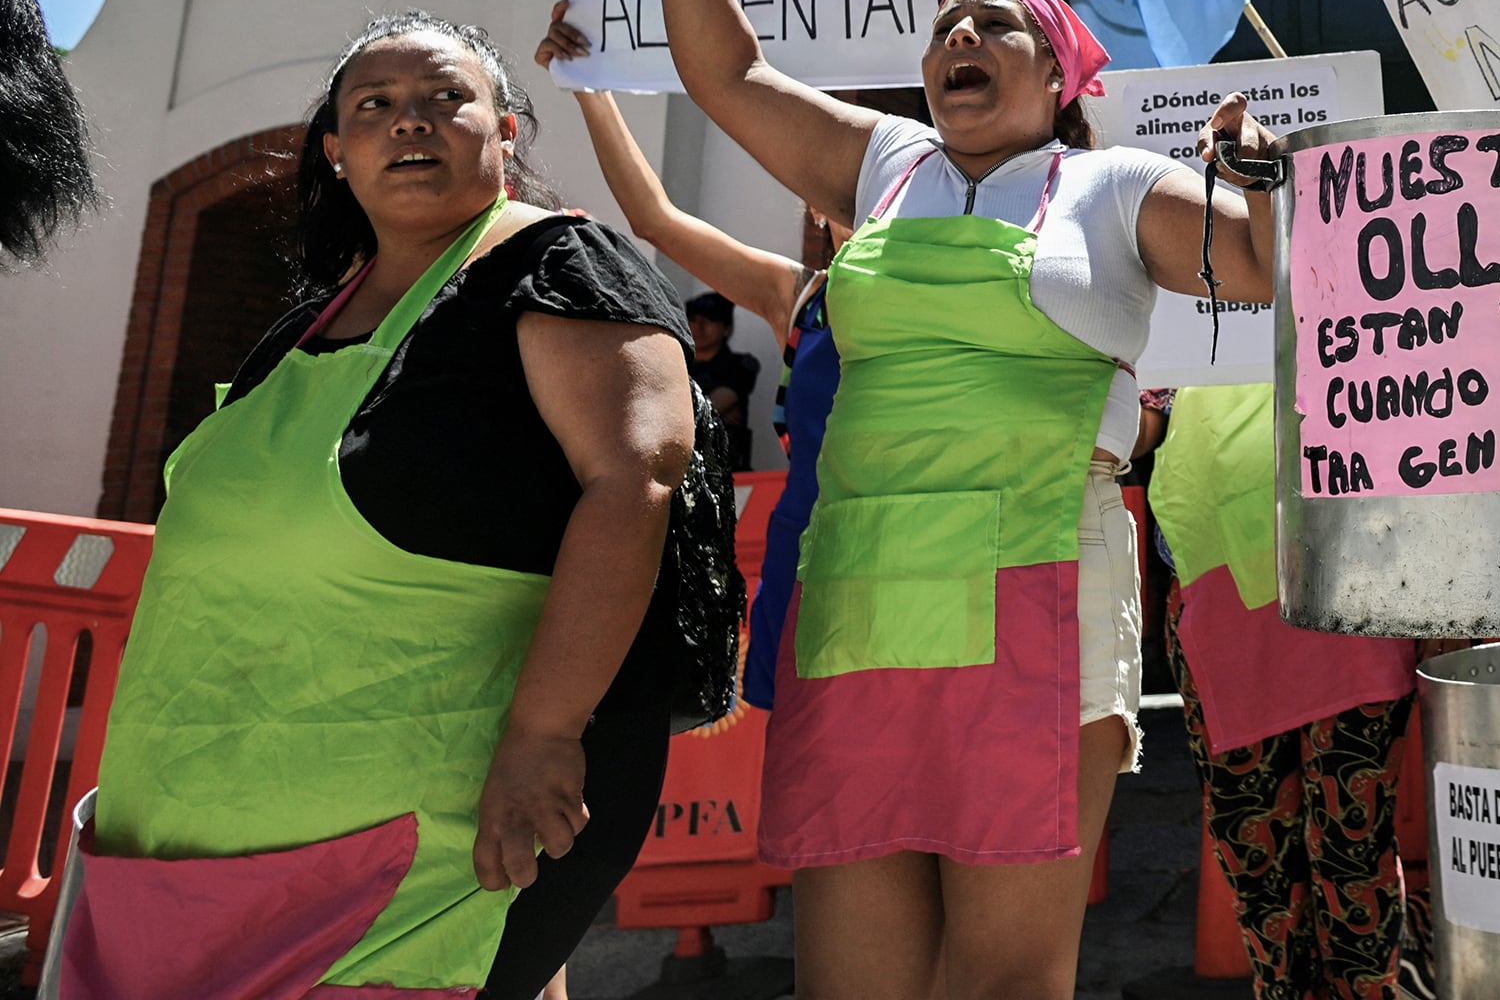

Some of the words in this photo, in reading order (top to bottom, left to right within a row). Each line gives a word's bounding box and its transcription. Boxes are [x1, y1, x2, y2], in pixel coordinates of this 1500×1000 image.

[1140, 90, 1222, 114] ¿Dónde
[1290, 82, 1321, 99] los
[1297, 107, 1328, 124] los
[1317, 301, 1463, 368] ESTAN
[654, 799, 743, 839] PFA
[1449, 782, 1491, 824] BASTA
[1451, 836, 1467, 874] AL
